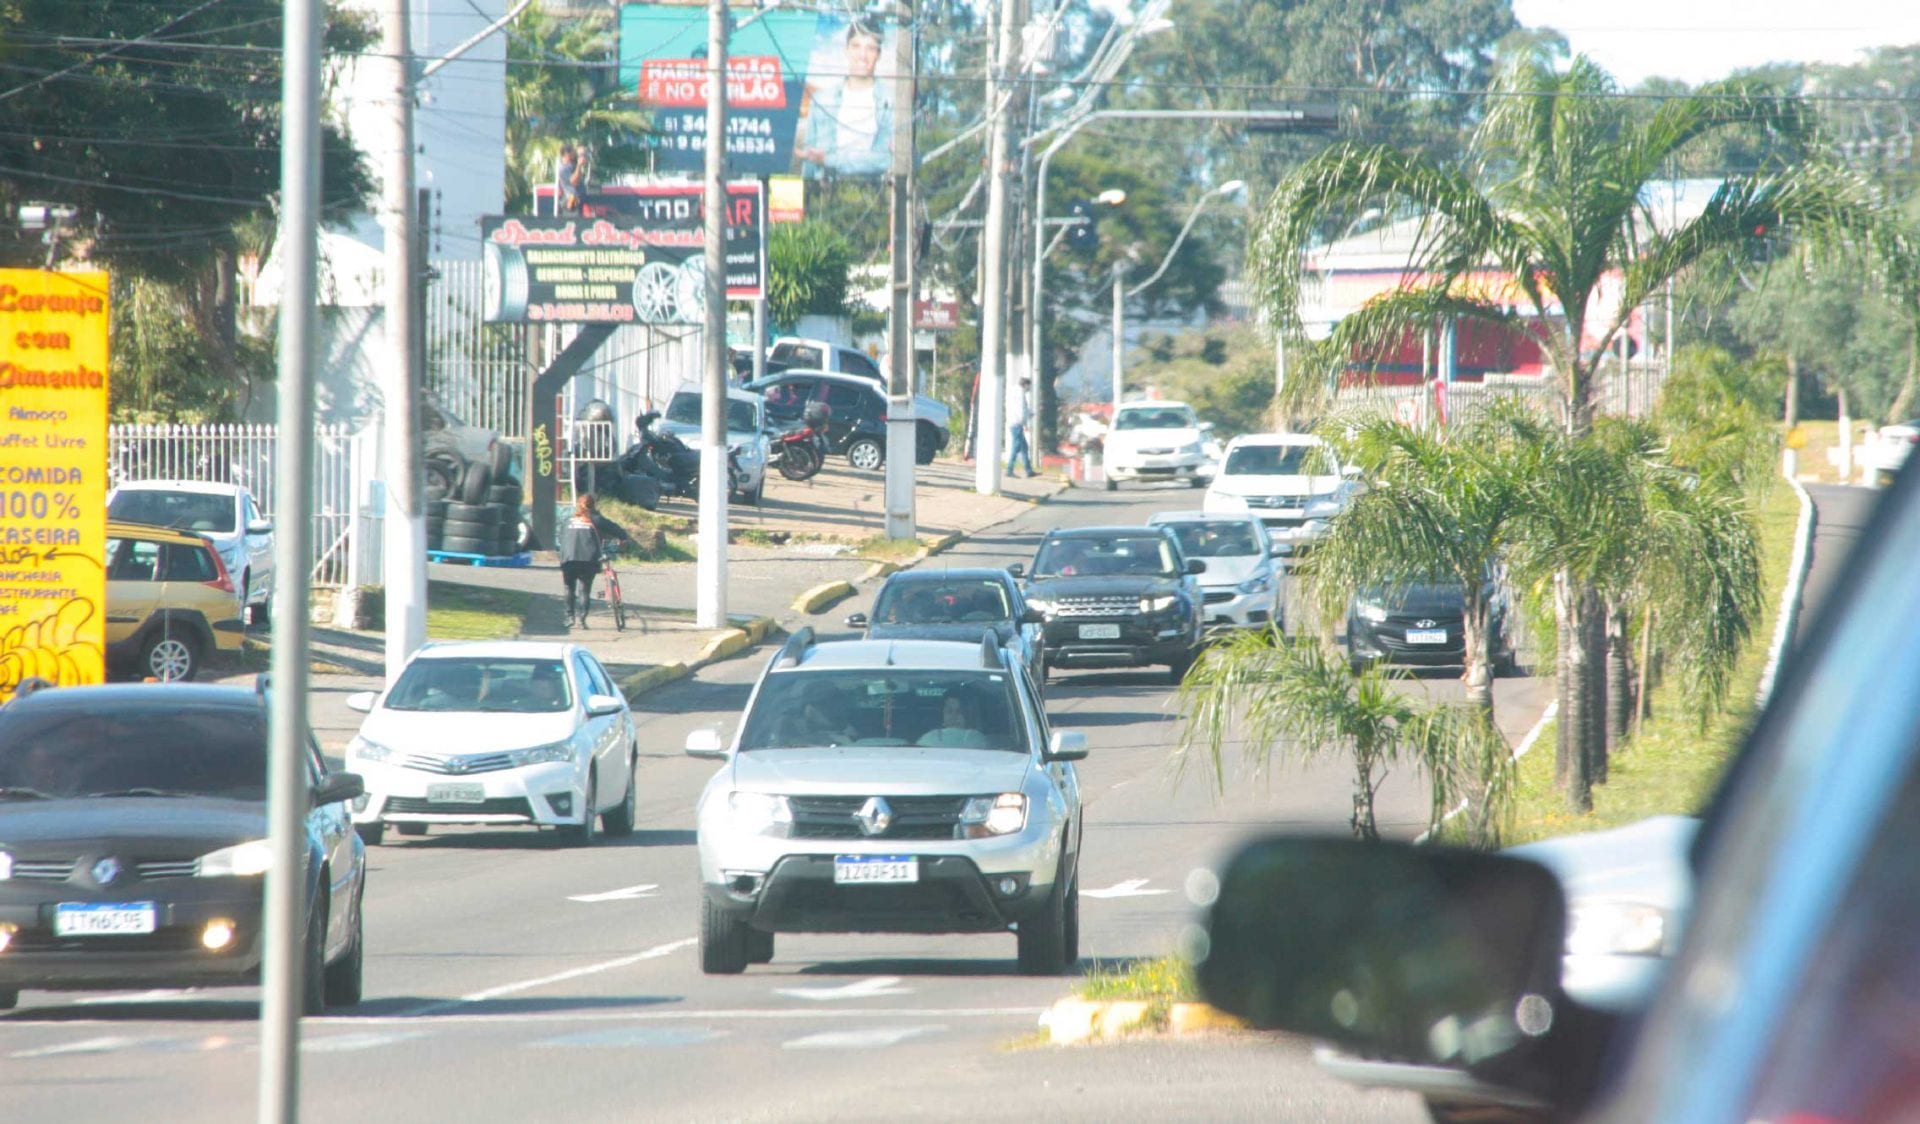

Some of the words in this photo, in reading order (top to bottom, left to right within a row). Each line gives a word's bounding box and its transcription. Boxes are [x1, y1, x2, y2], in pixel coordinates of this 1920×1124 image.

[665, 82, 695, 100] NO
[16, 331, 70, 349] com
[0, 433, 38, 448] uffet
[45, 433, 85, 448] Livre
[0, 527, 79, 545] ASEIRA
